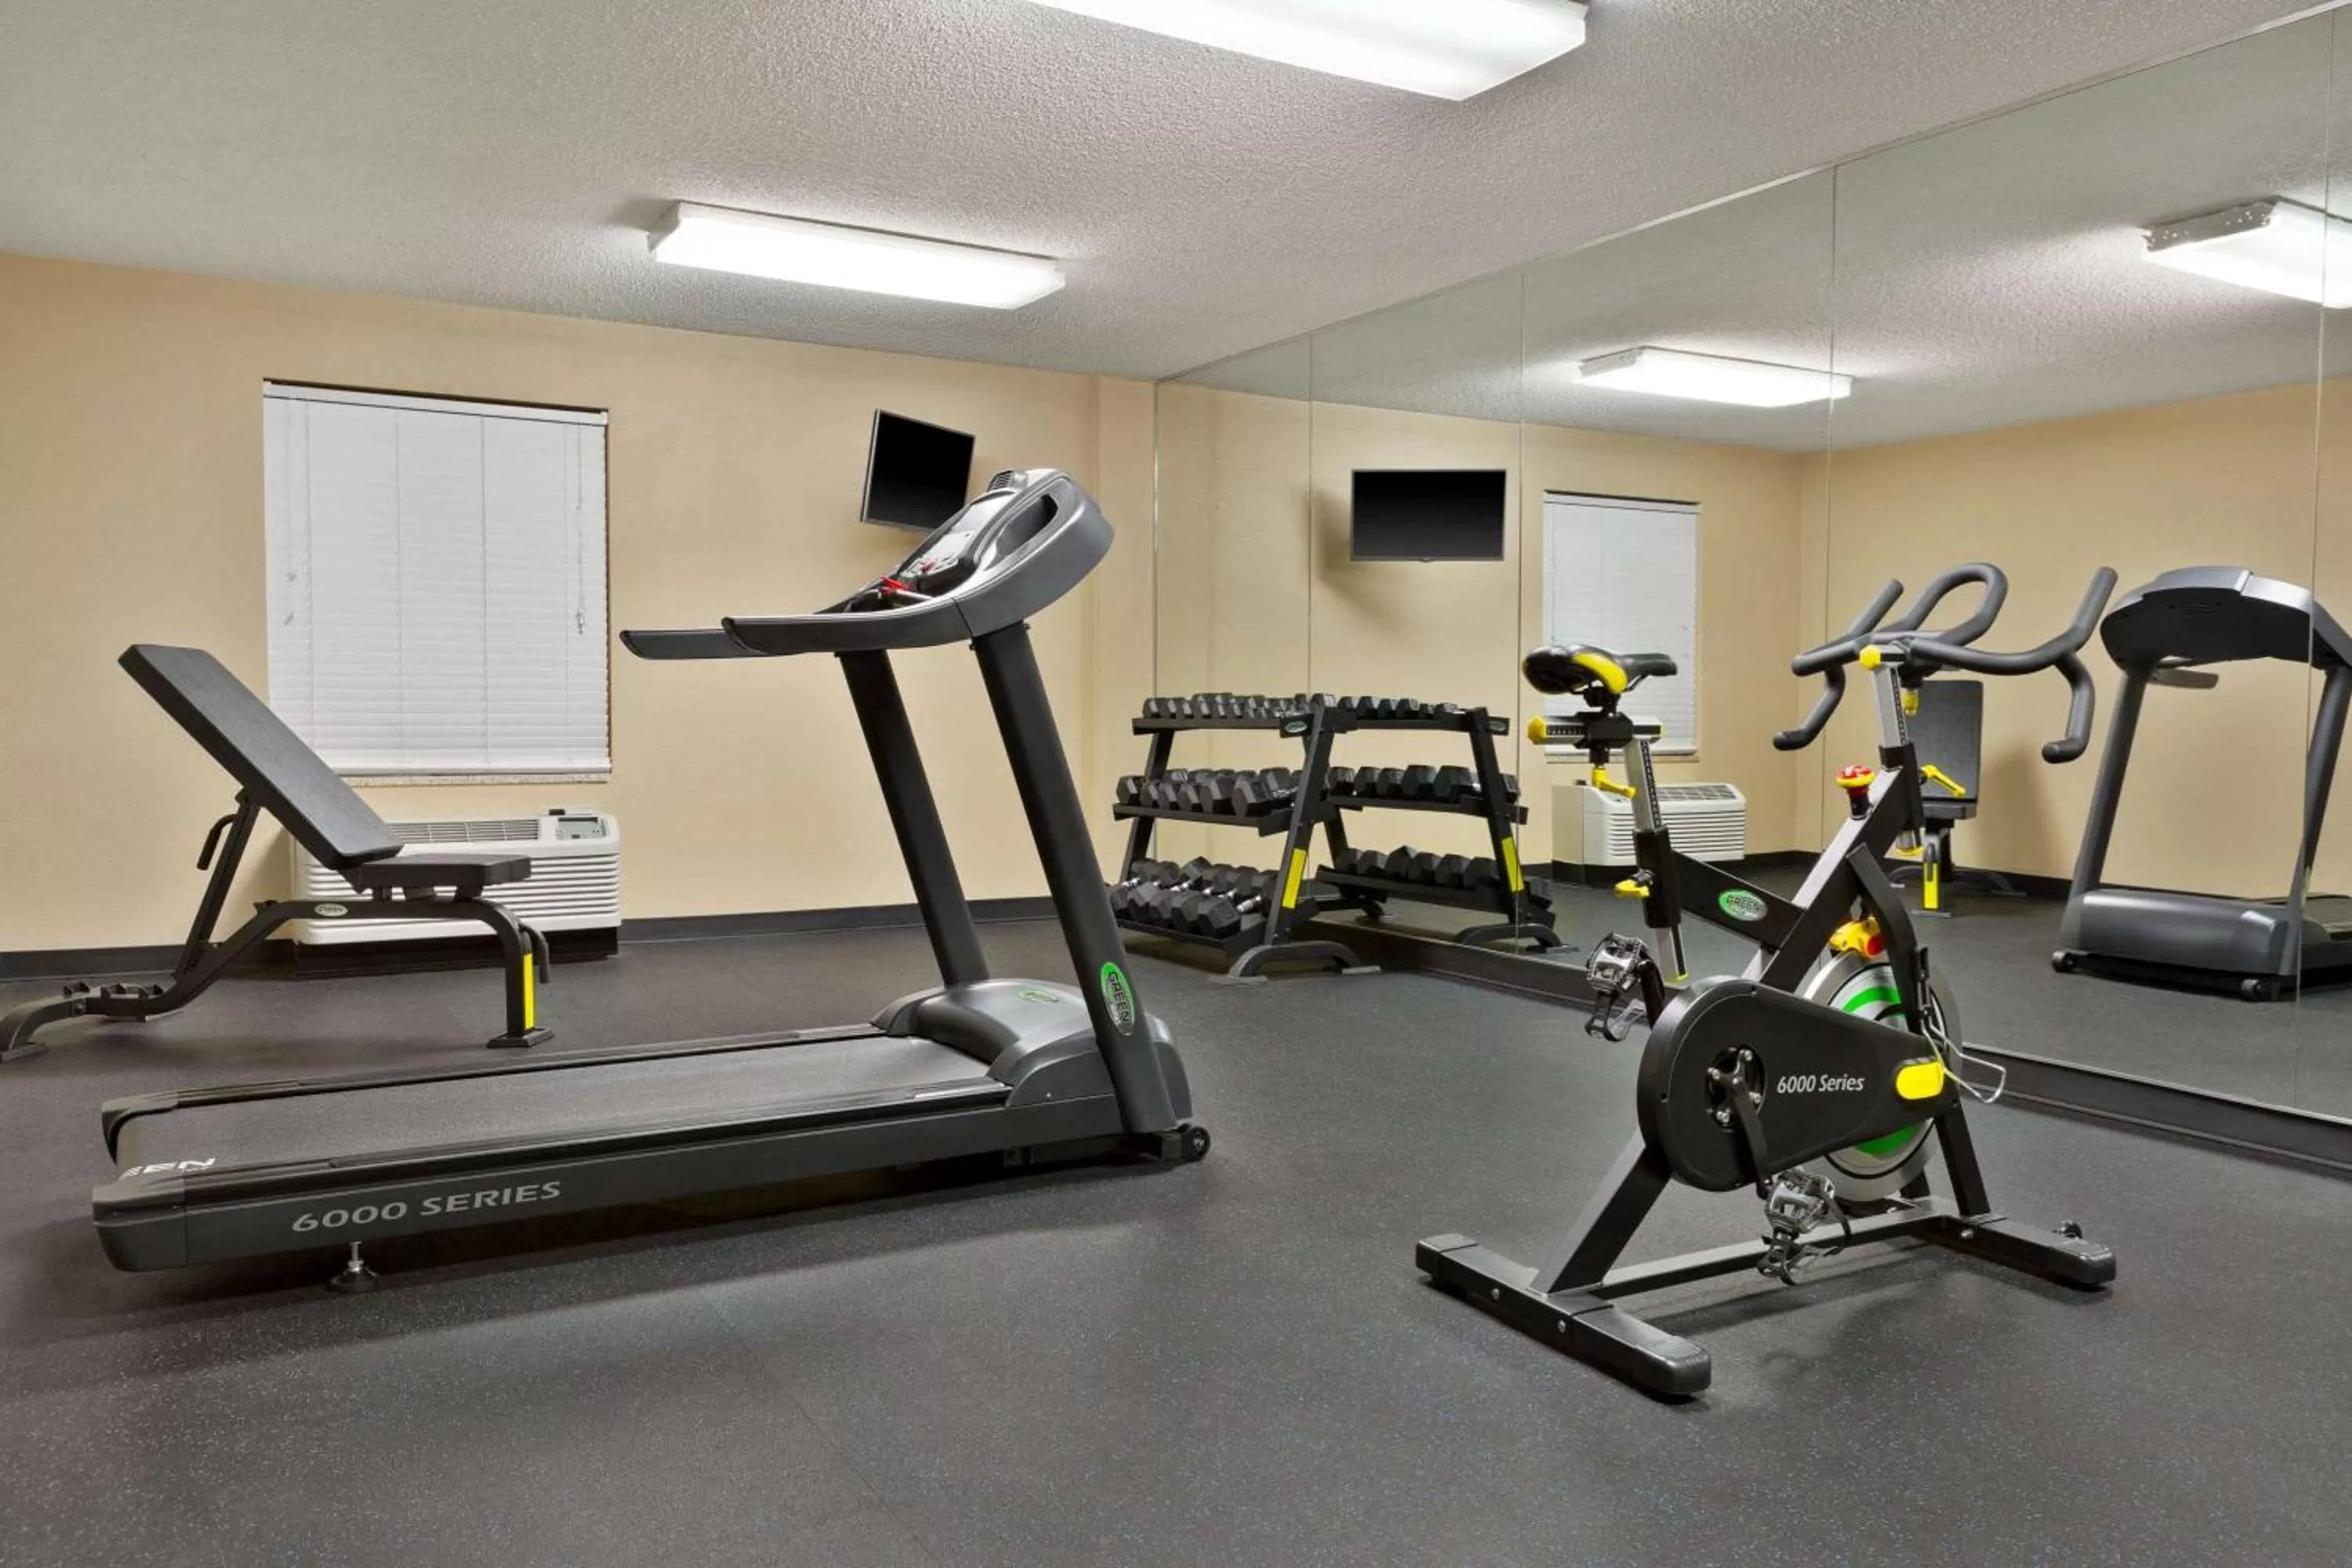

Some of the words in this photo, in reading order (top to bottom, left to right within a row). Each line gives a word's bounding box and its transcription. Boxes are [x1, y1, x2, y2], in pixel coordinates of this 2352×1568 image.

[1107, 971, 1131, 1022] GREEN
[1777, 1074, 1817, 1094] 6000
[1818, 1073, 1866, 1092] Series
[292, 1201, 408, 1232] 6000
[419, 1181, 561, 1216] SERIES
